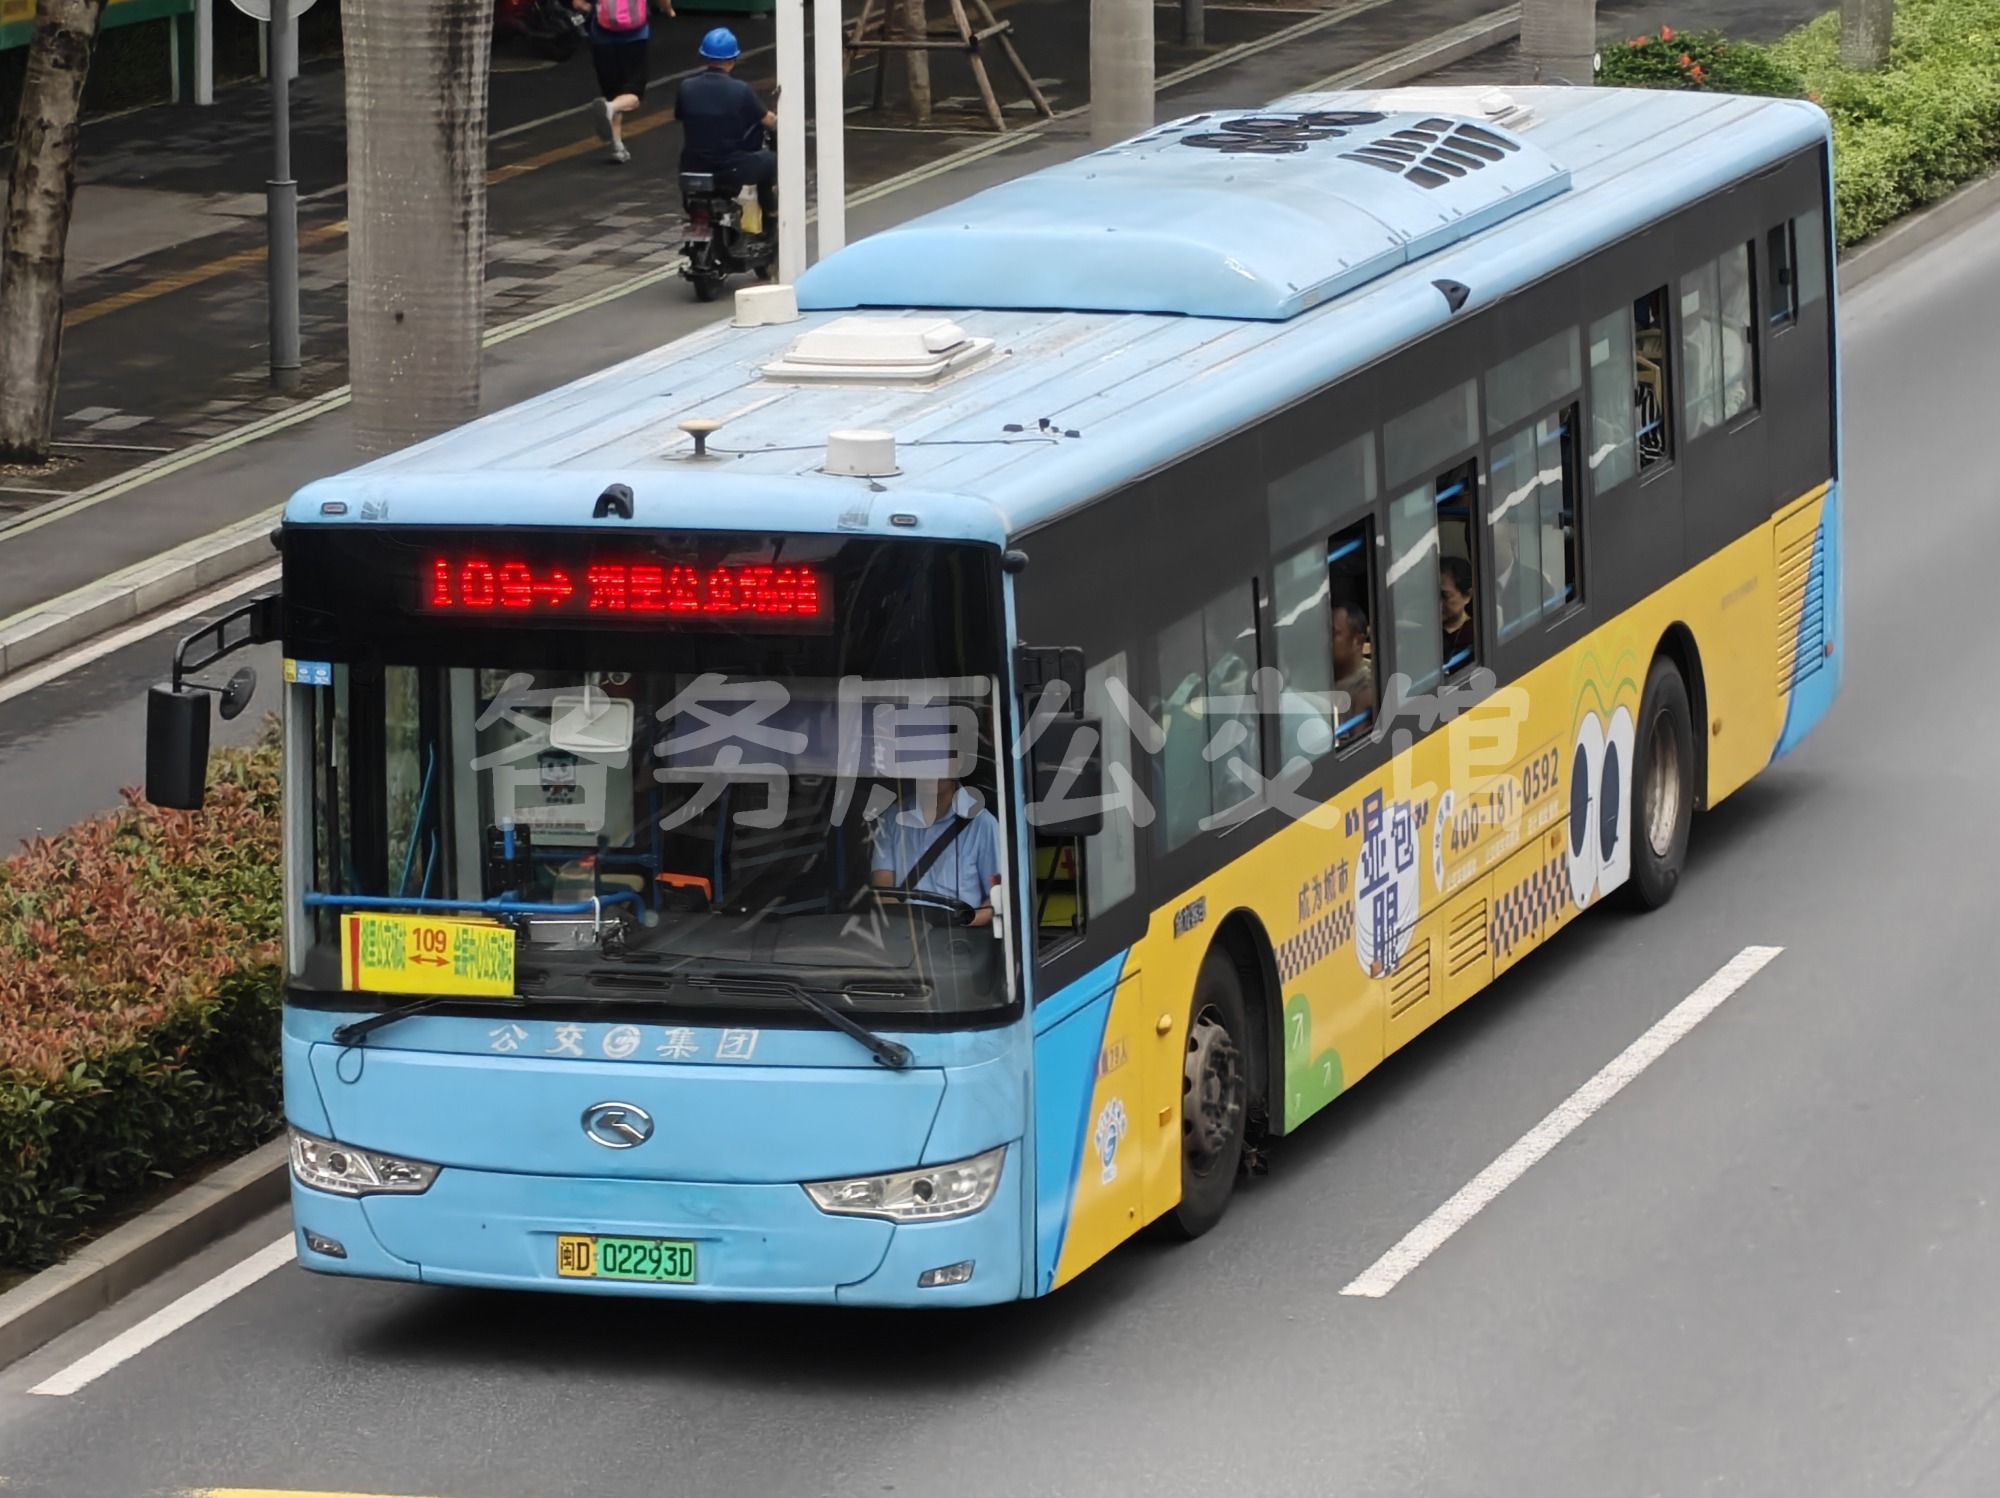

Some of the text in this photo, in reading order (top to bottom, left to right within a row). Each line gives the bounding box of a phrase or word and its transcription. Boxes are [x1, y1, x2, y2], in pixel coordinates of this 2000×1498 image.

[433, 558, 532, 608] 109
[1450, 747, 1559, 853] 400-181-0592
[1298, 858, 1349, 924] 成为城市
[412, 927, 448, 954] 109
